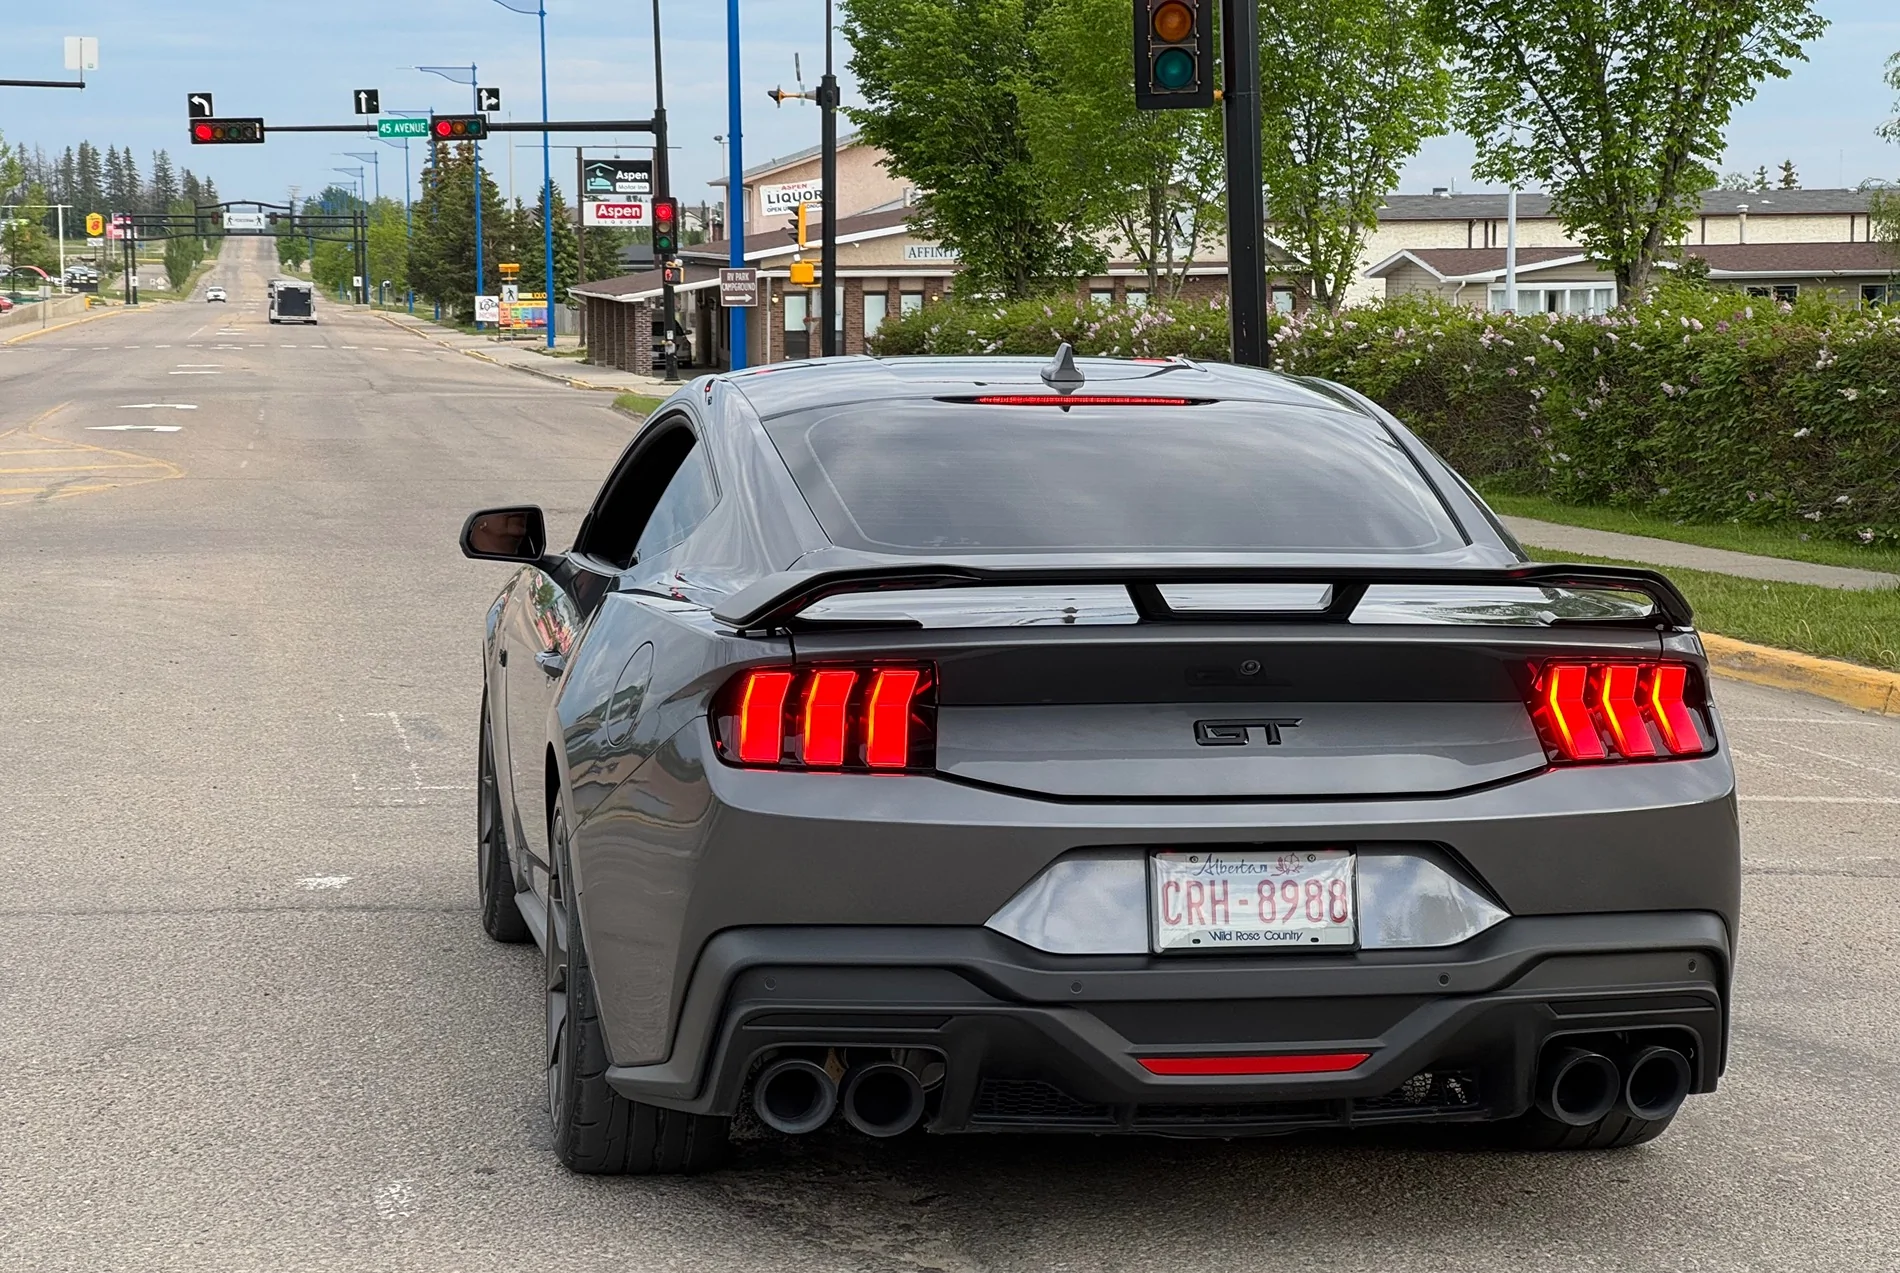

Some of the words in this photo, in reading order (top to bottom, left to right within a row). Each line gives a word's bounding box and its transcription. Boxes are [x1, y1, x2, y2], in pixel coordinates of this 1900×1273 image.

[380, 123, 391, 133] 45
[394, 122, 426, 133] AVENUE
[616, 170, 648, 181] Aspen
[781, 183, 808, 191] ASPEN
[767, 189, 822, 204] LIQUOR
[597, 204, 640, 219] Aspen
[735, 272, 750, 281] PARK
[722, 282, 756, 291] CAMPGROUND
[1193, 718, 1302, 746] GT
[1193, 854, 1263, 876] Alberta
[1162, 879, 1348, 925] CRH-8988
[1208, 931, 1232, 941] Wild
[1235, 931, 1260, 941] Rose
[1264, 930, 1303, 942] Country
